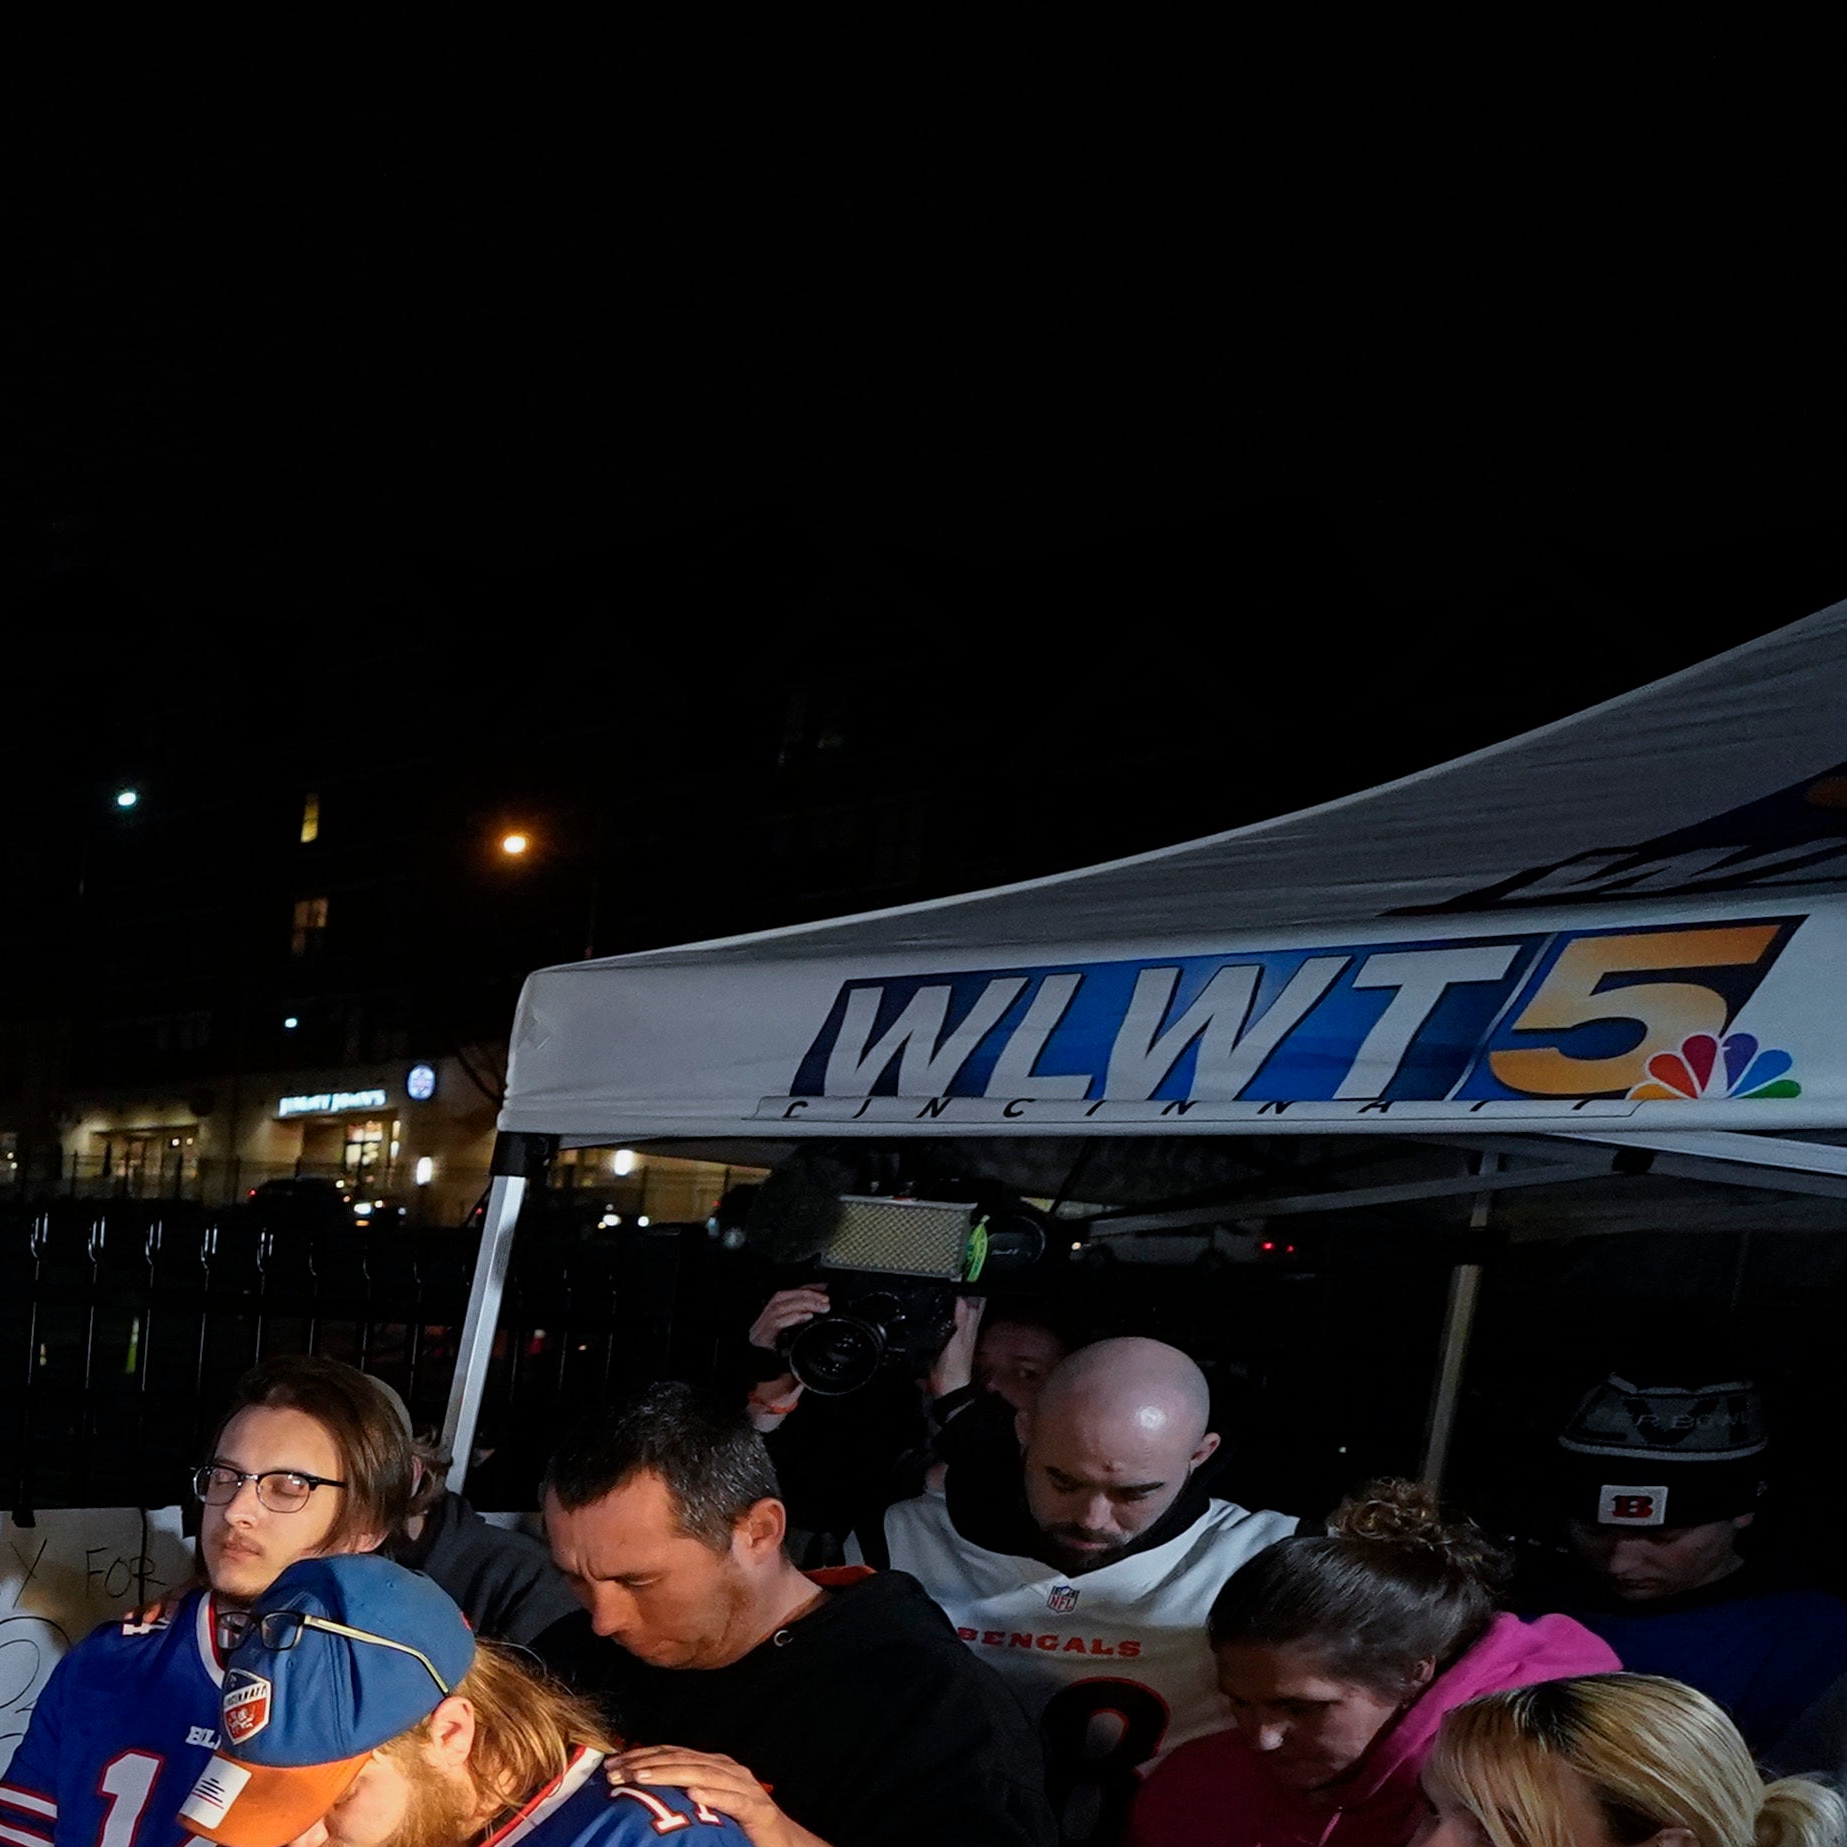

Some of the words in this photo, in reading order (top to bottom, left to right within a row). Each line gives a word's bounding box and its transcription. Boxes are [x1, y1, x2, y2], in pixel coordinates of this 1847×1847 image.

[822, 945, 1516, 1100] WLWT
[1487, 923, 1784, 1098] 5
[1610, 1495, 1654, 1518] B
[85, 1547, 167, 1603] FOR
[1050, 1597, 1074, 1610] NFL
[957, 1626, 1142, 1658] BENGALS
[185, 1725, 222, 1750] BIL
